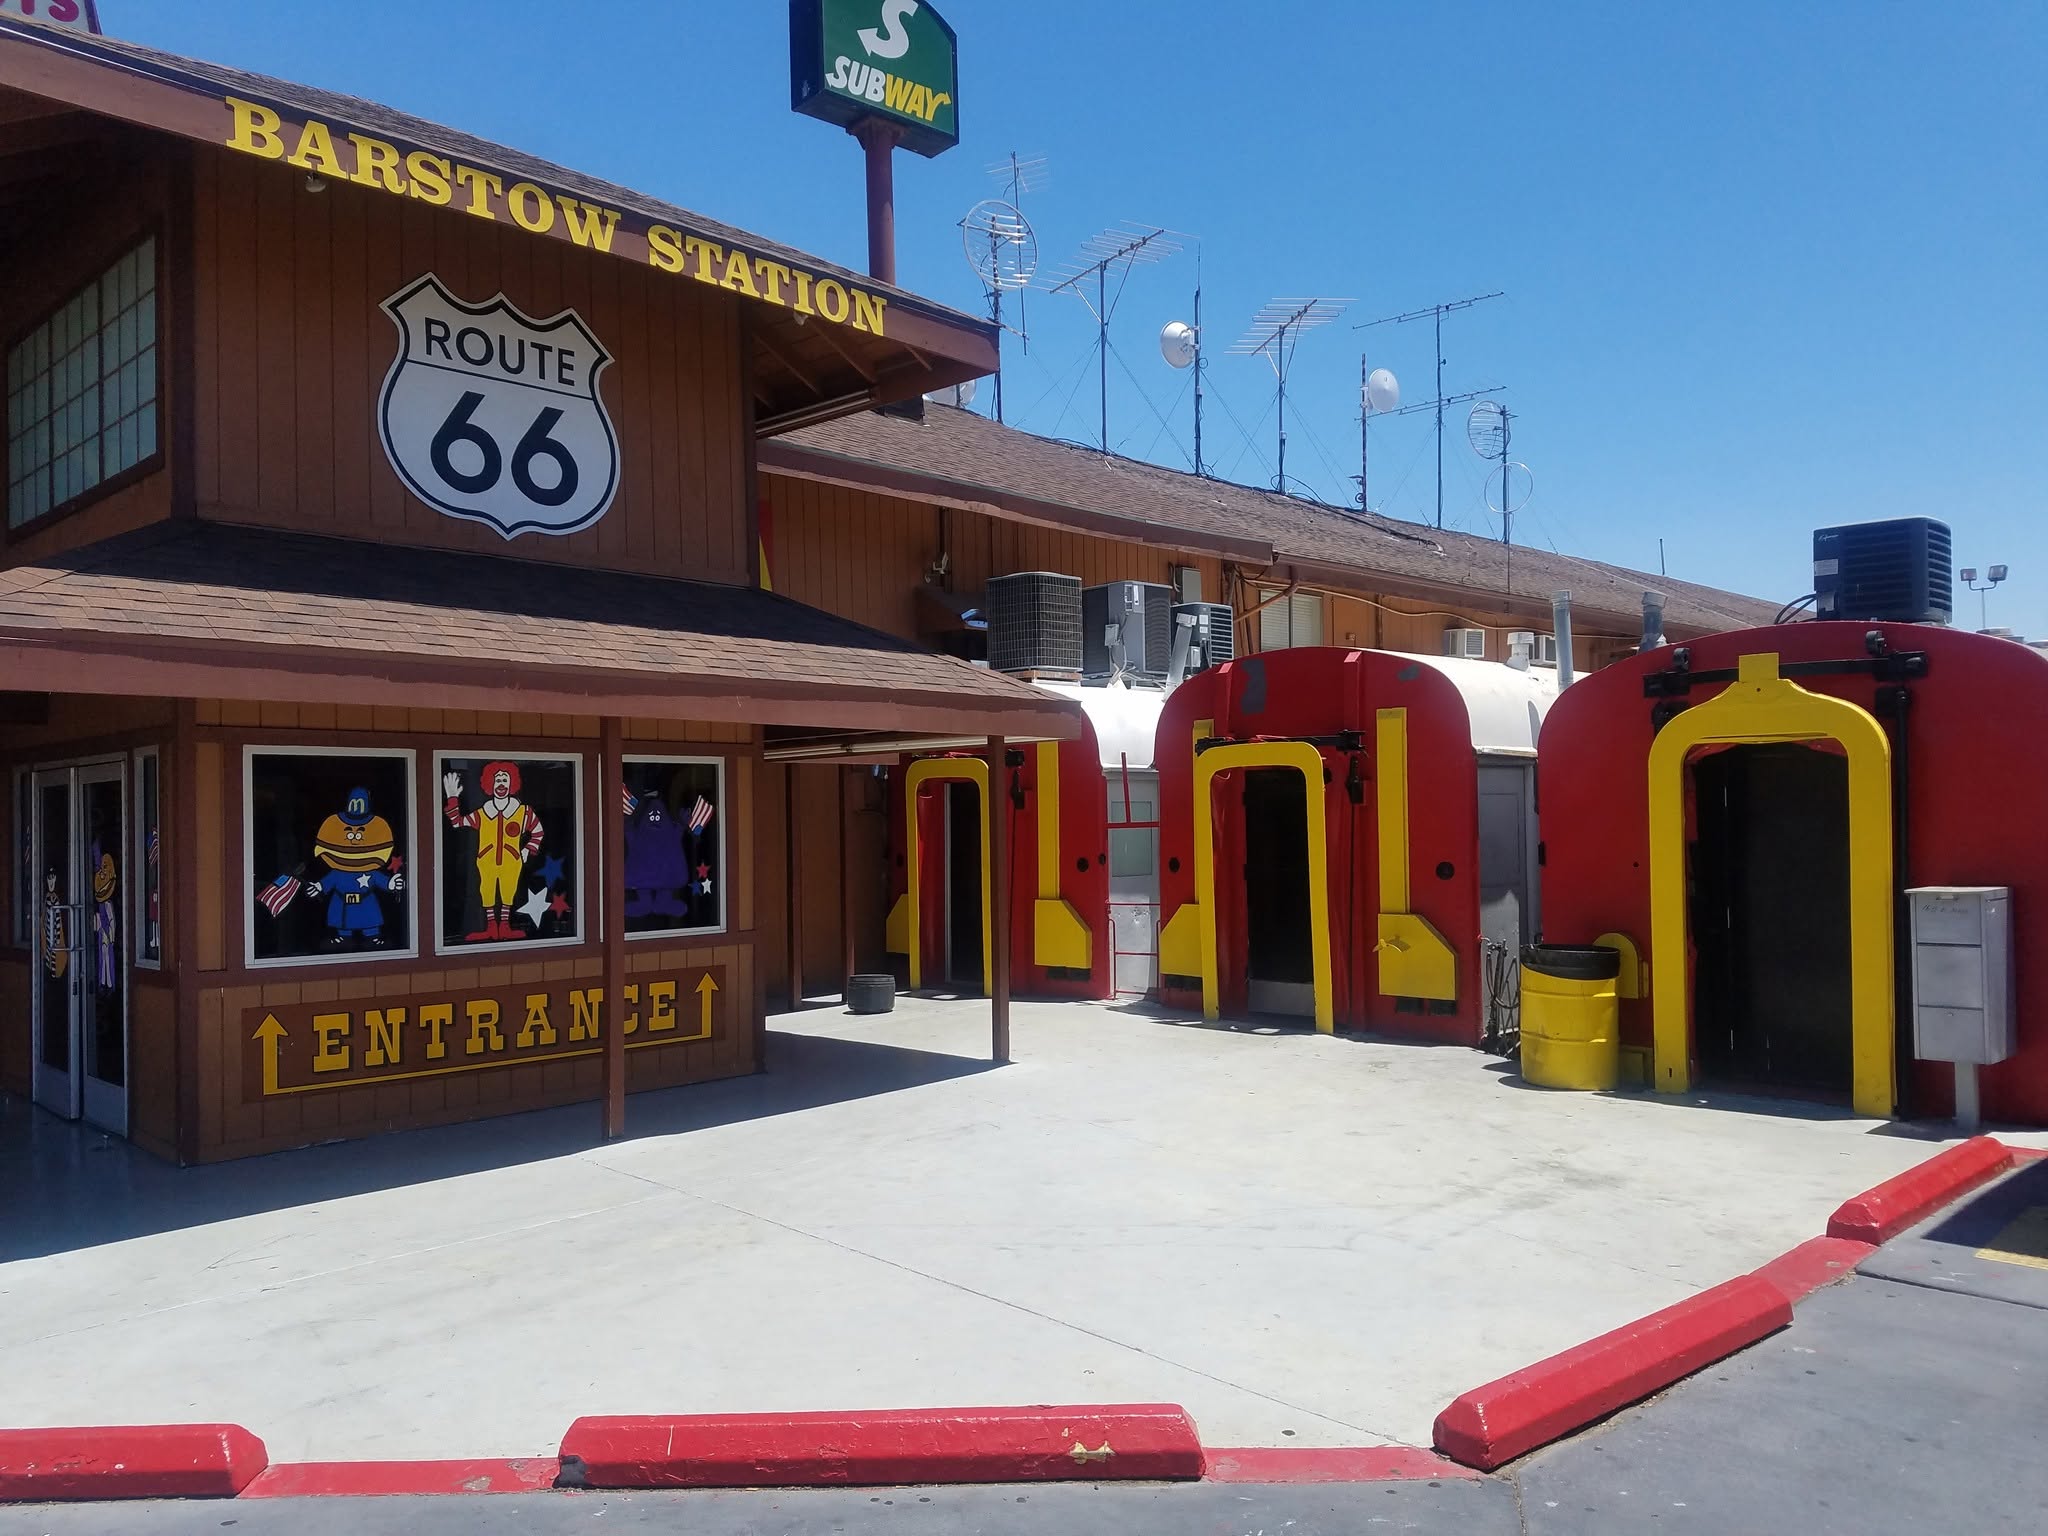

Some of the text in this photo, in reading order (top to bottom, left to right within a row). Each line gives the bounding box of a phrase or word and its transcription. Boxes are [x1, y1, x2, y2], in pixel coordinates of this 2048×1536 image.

[825, 55, 952, 122] SUBWAY
[225, 96, 888, 337] BARSTOW STATION
[424, 317, 576, 387] ROUTE
[430, 391, 579, 506] 66
